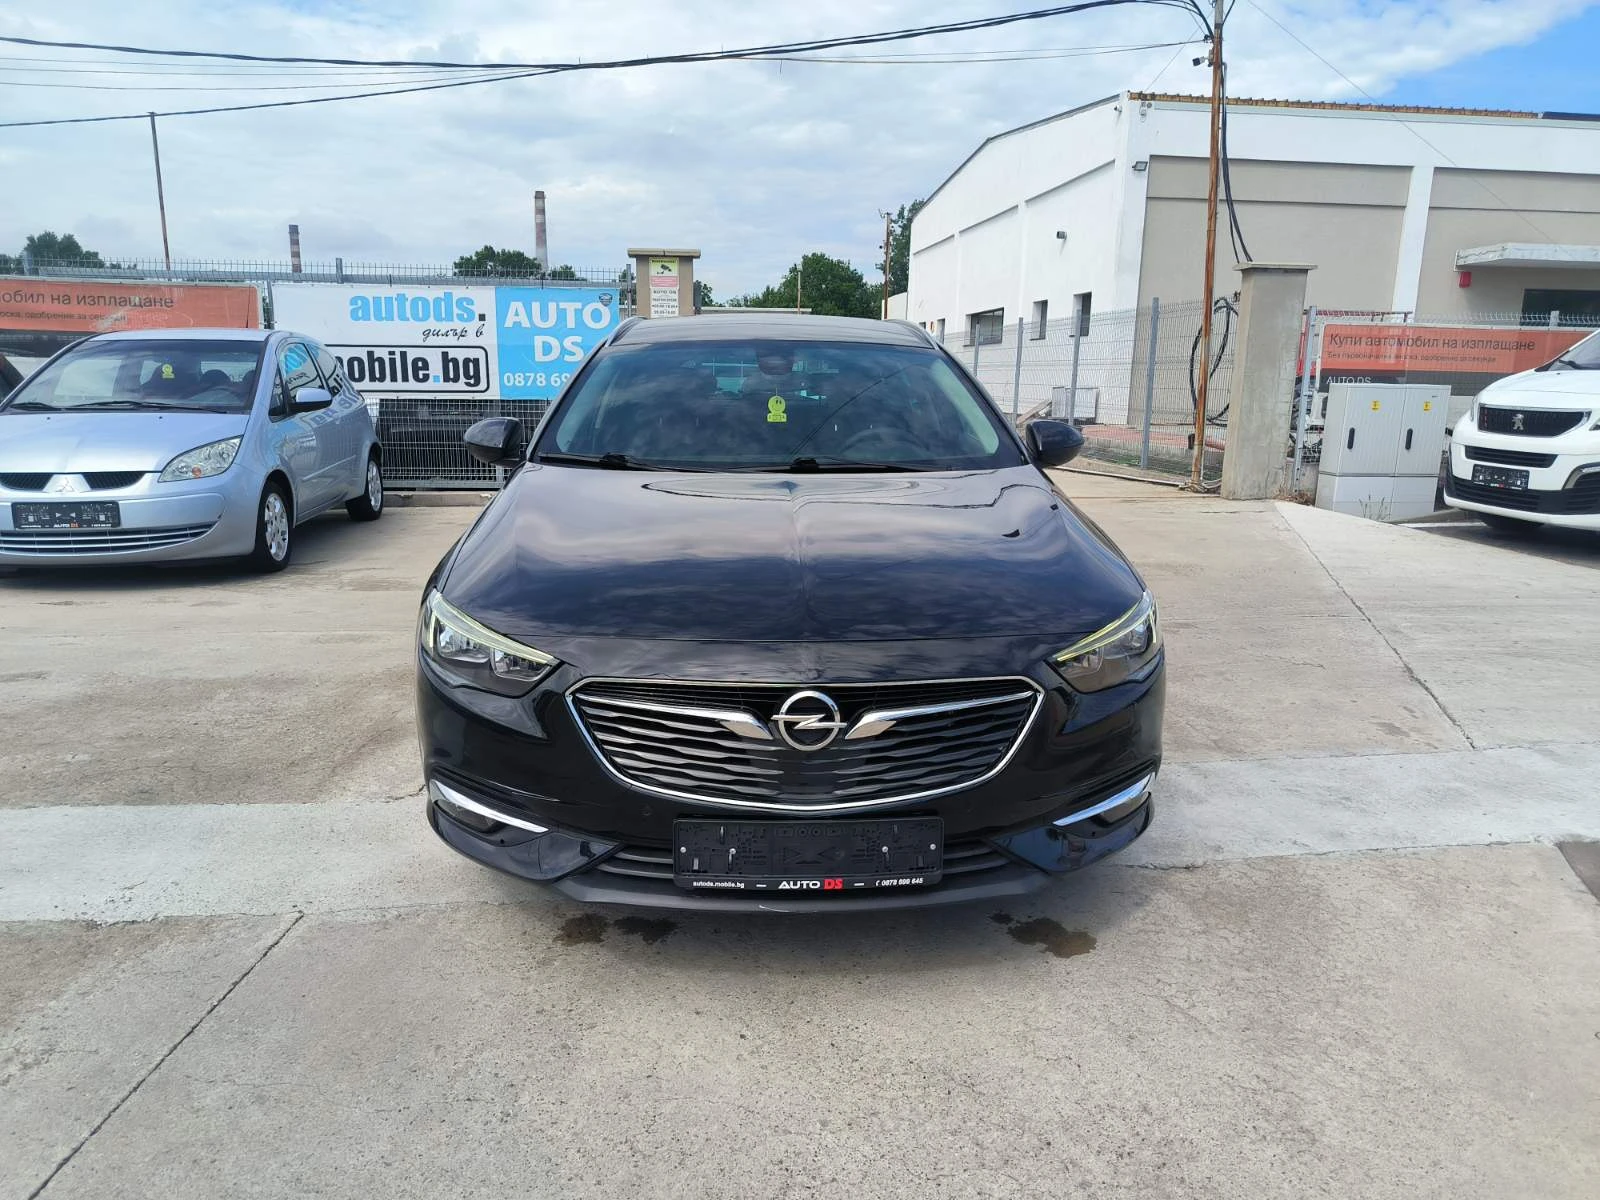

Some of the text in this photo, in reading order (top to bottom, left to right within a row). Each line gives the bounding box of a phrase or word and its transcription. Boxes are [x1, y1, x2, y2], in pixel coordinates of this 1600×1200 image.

[0, 290, 174, 309] обил на изплащане
[504, 301, 611, 329] AUTO
[422, 327, 468, 342] дилър
[1329, 334, 1536, 352] Купи автомобил на изплащане
[534, 336, 585, 362] DS
[503, 373, 546, 386] 0878
[778, 881, 820, 889] AUTO
[823, 879, 843, 890] DS
